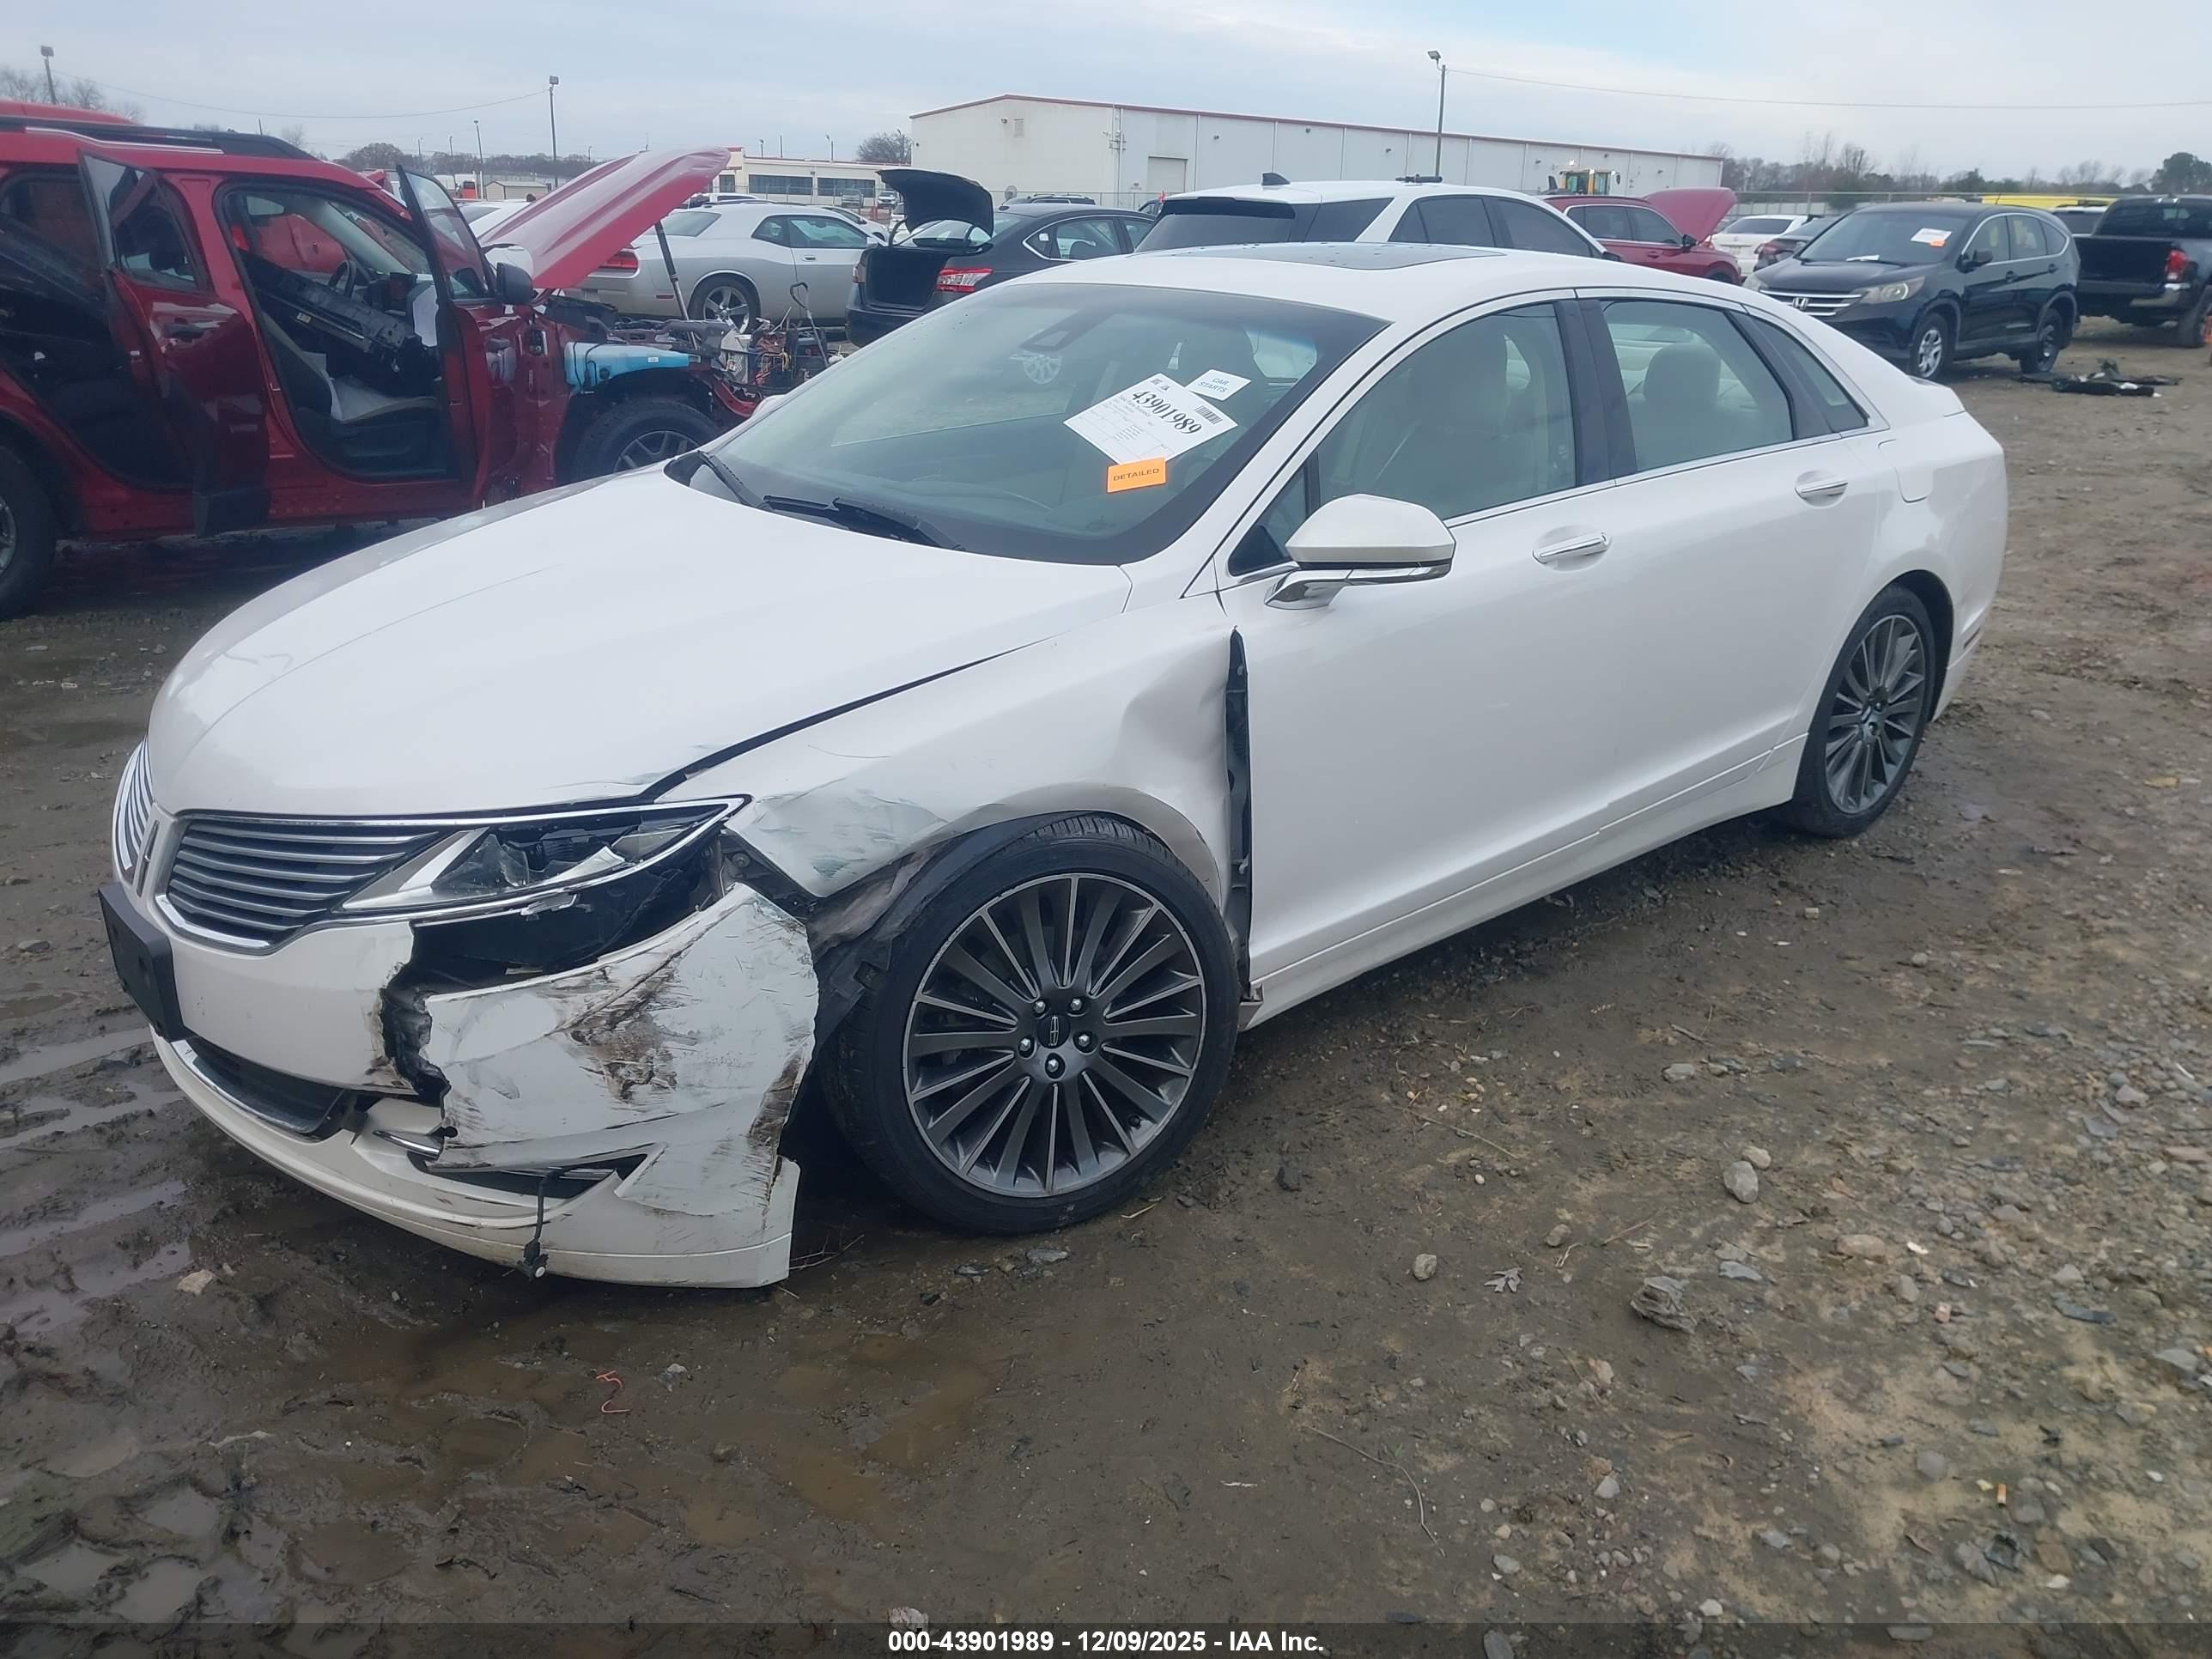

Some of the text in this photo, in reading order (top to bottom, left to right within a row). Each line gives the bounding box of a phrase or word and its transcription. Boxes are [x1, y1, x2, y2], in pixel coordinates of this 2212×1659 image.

[1198, 381, 1227, 393] STARTS
[1212, 378, 1230, 386] CAR
[1132, 391, 1202, 434] 43901989
[1113, 468, 1160, 481] DETAILED
